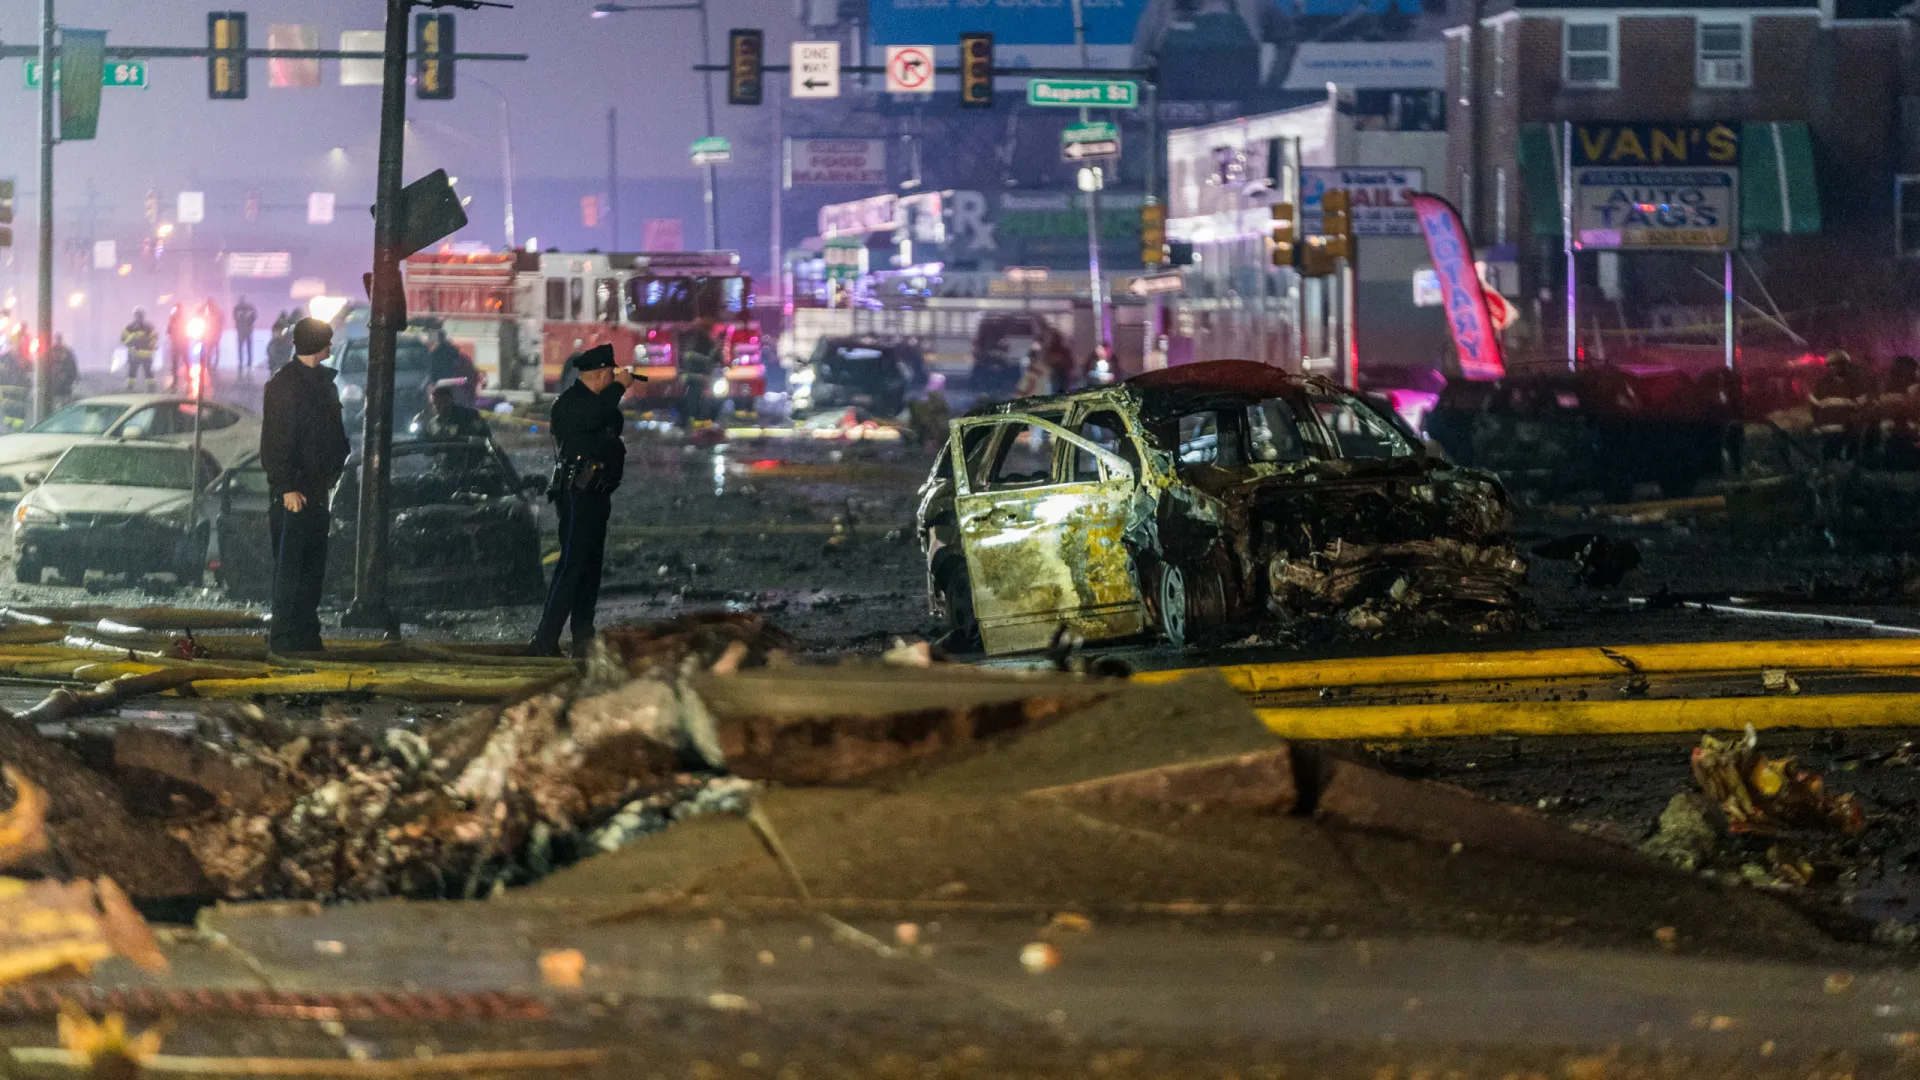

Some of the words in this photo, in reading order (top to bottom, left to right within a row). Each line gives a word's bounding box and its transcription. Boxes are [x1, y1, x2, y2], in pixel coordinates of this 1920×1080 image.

[803, 47, 830, 59] ONE
[115, 65, 138, 82] St
[802, 62, 830, 73] WAY
[1036, 84, 1101, 101] Rupert
[1107, 84, 1129, 101] St
[1579, 125, 1737, 161] VAN'S
[1351, 188, 1415, 207] AILS
[1608, 187, 1706, 206] AUTO
[1592, 205, 1717, 228] TAGS
[1424, 209, 1481, 358] NOTARY
